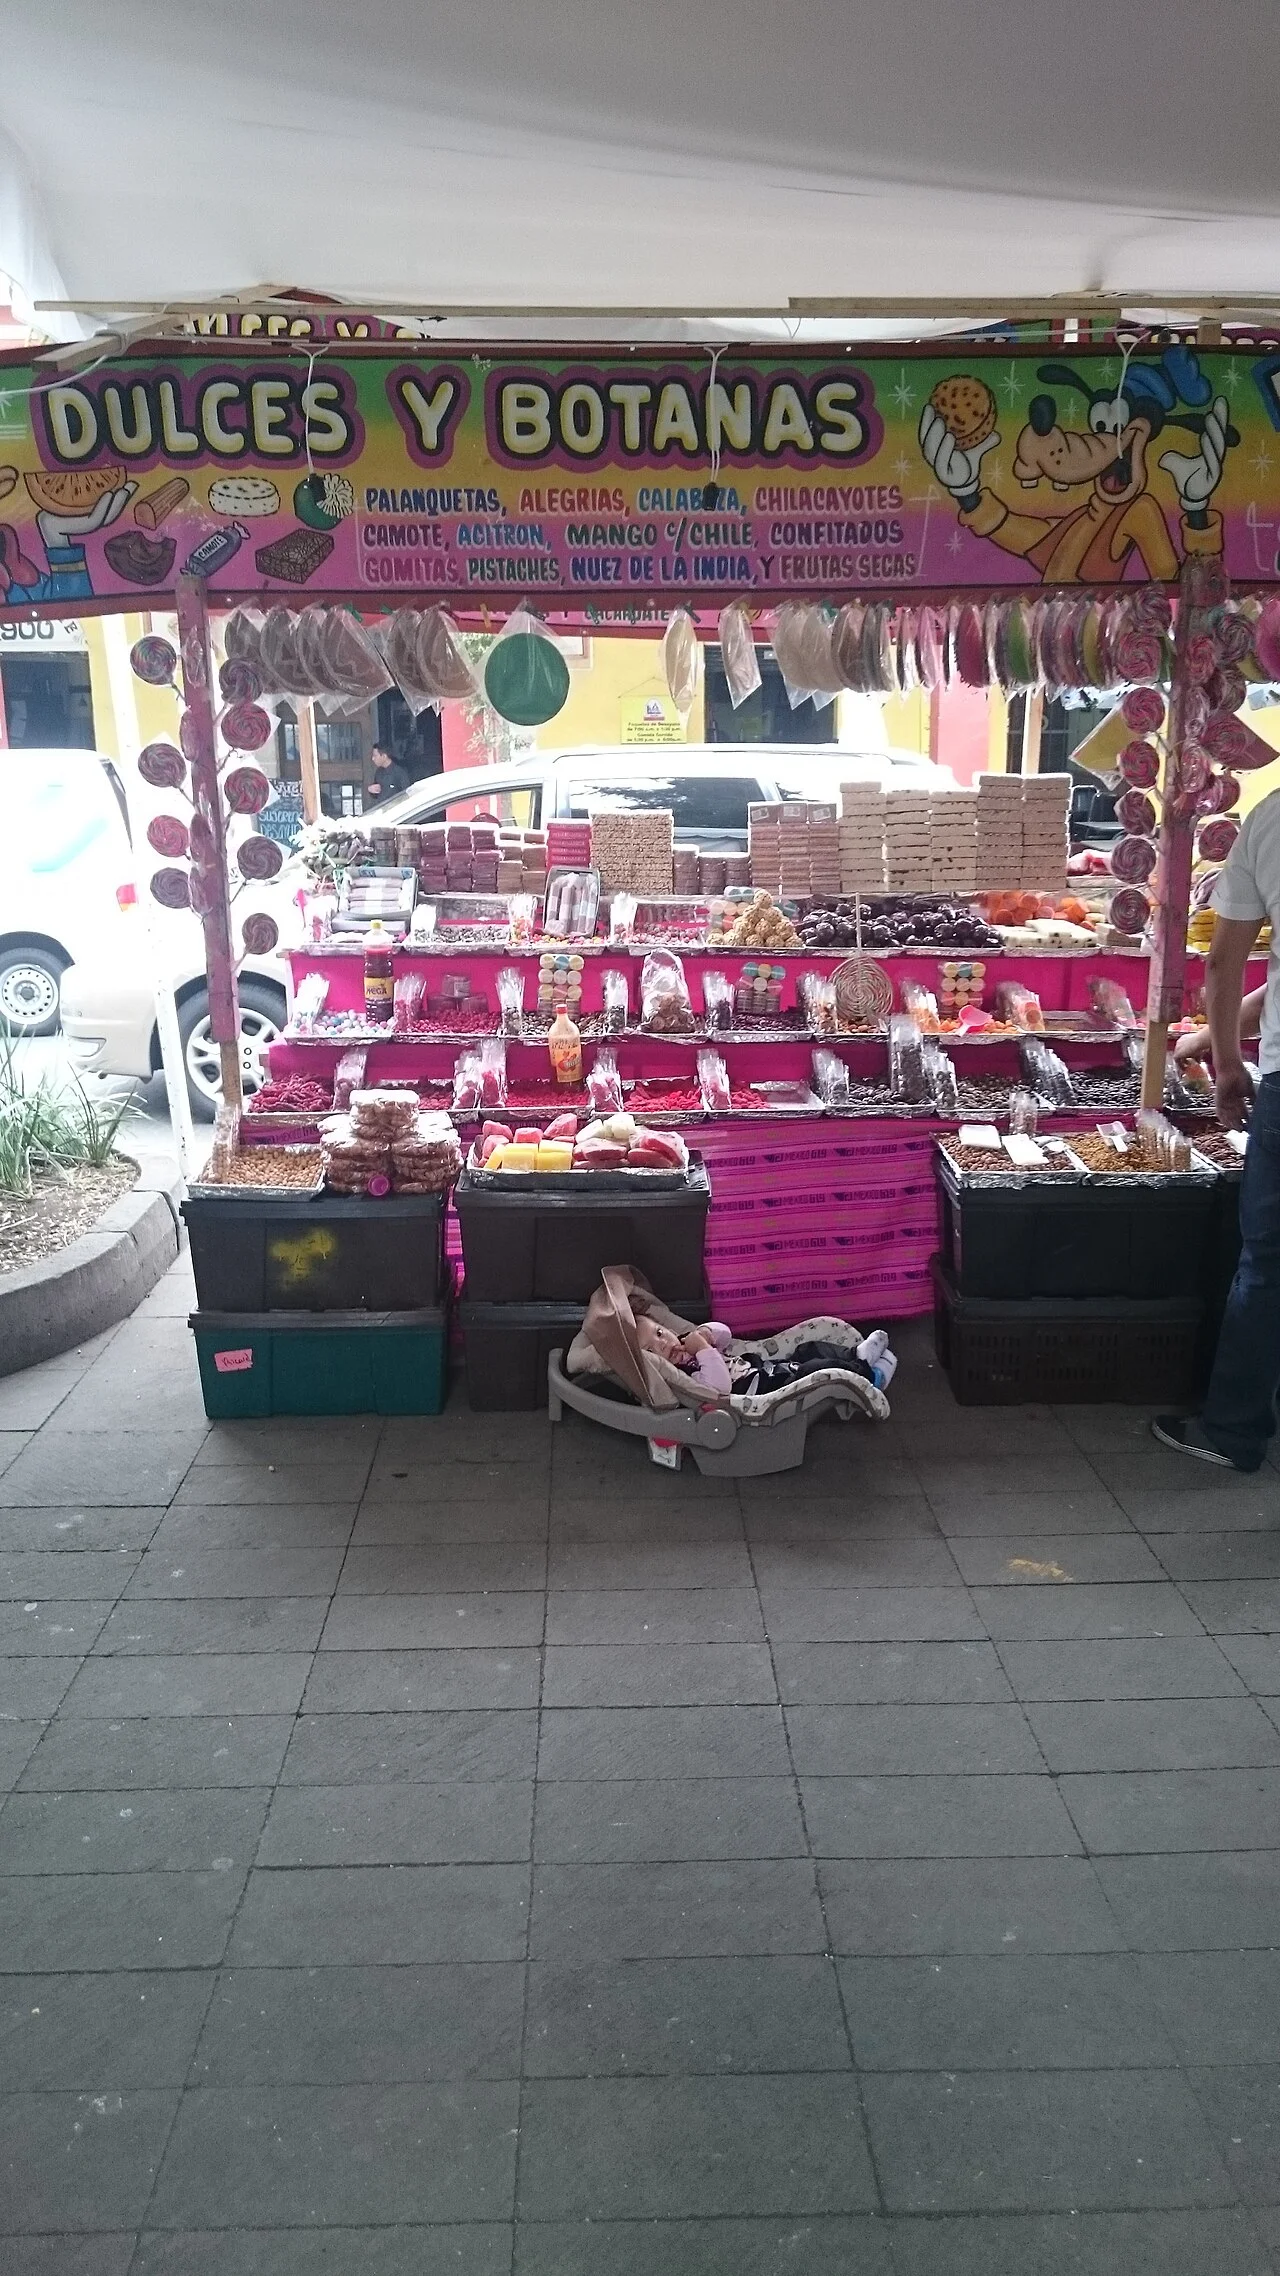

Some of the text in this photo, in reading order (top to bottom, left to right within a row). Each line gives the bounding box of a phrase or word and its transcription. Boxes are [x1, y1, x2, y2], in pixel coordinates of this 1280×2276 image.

[46, 379, 858, 459] DULCES Y BOTANAS
[365, 485, 904, 517] PALANQUETAS, ALEGRIAS, CALABZA, CHILACAYOTES
[198, 536, 224, 559] CAMOTE
[363, 524, 449, 552] CAMOTE,
[457, 523, 552, 552] ACITRON,
[567, 523, 658, 546] MANGO
[770, 519, 904, 546] CONFITADOS
[467, 556, 566, 586] PISTACHES,
[571, 555, 622, 581] NUEZ
[629, 555, 654, 581] DE
[661, 556, 688, 581] LA
[781, 554, 852, 580] FRUTAS
[857, 553, 917, 579] SECAS
